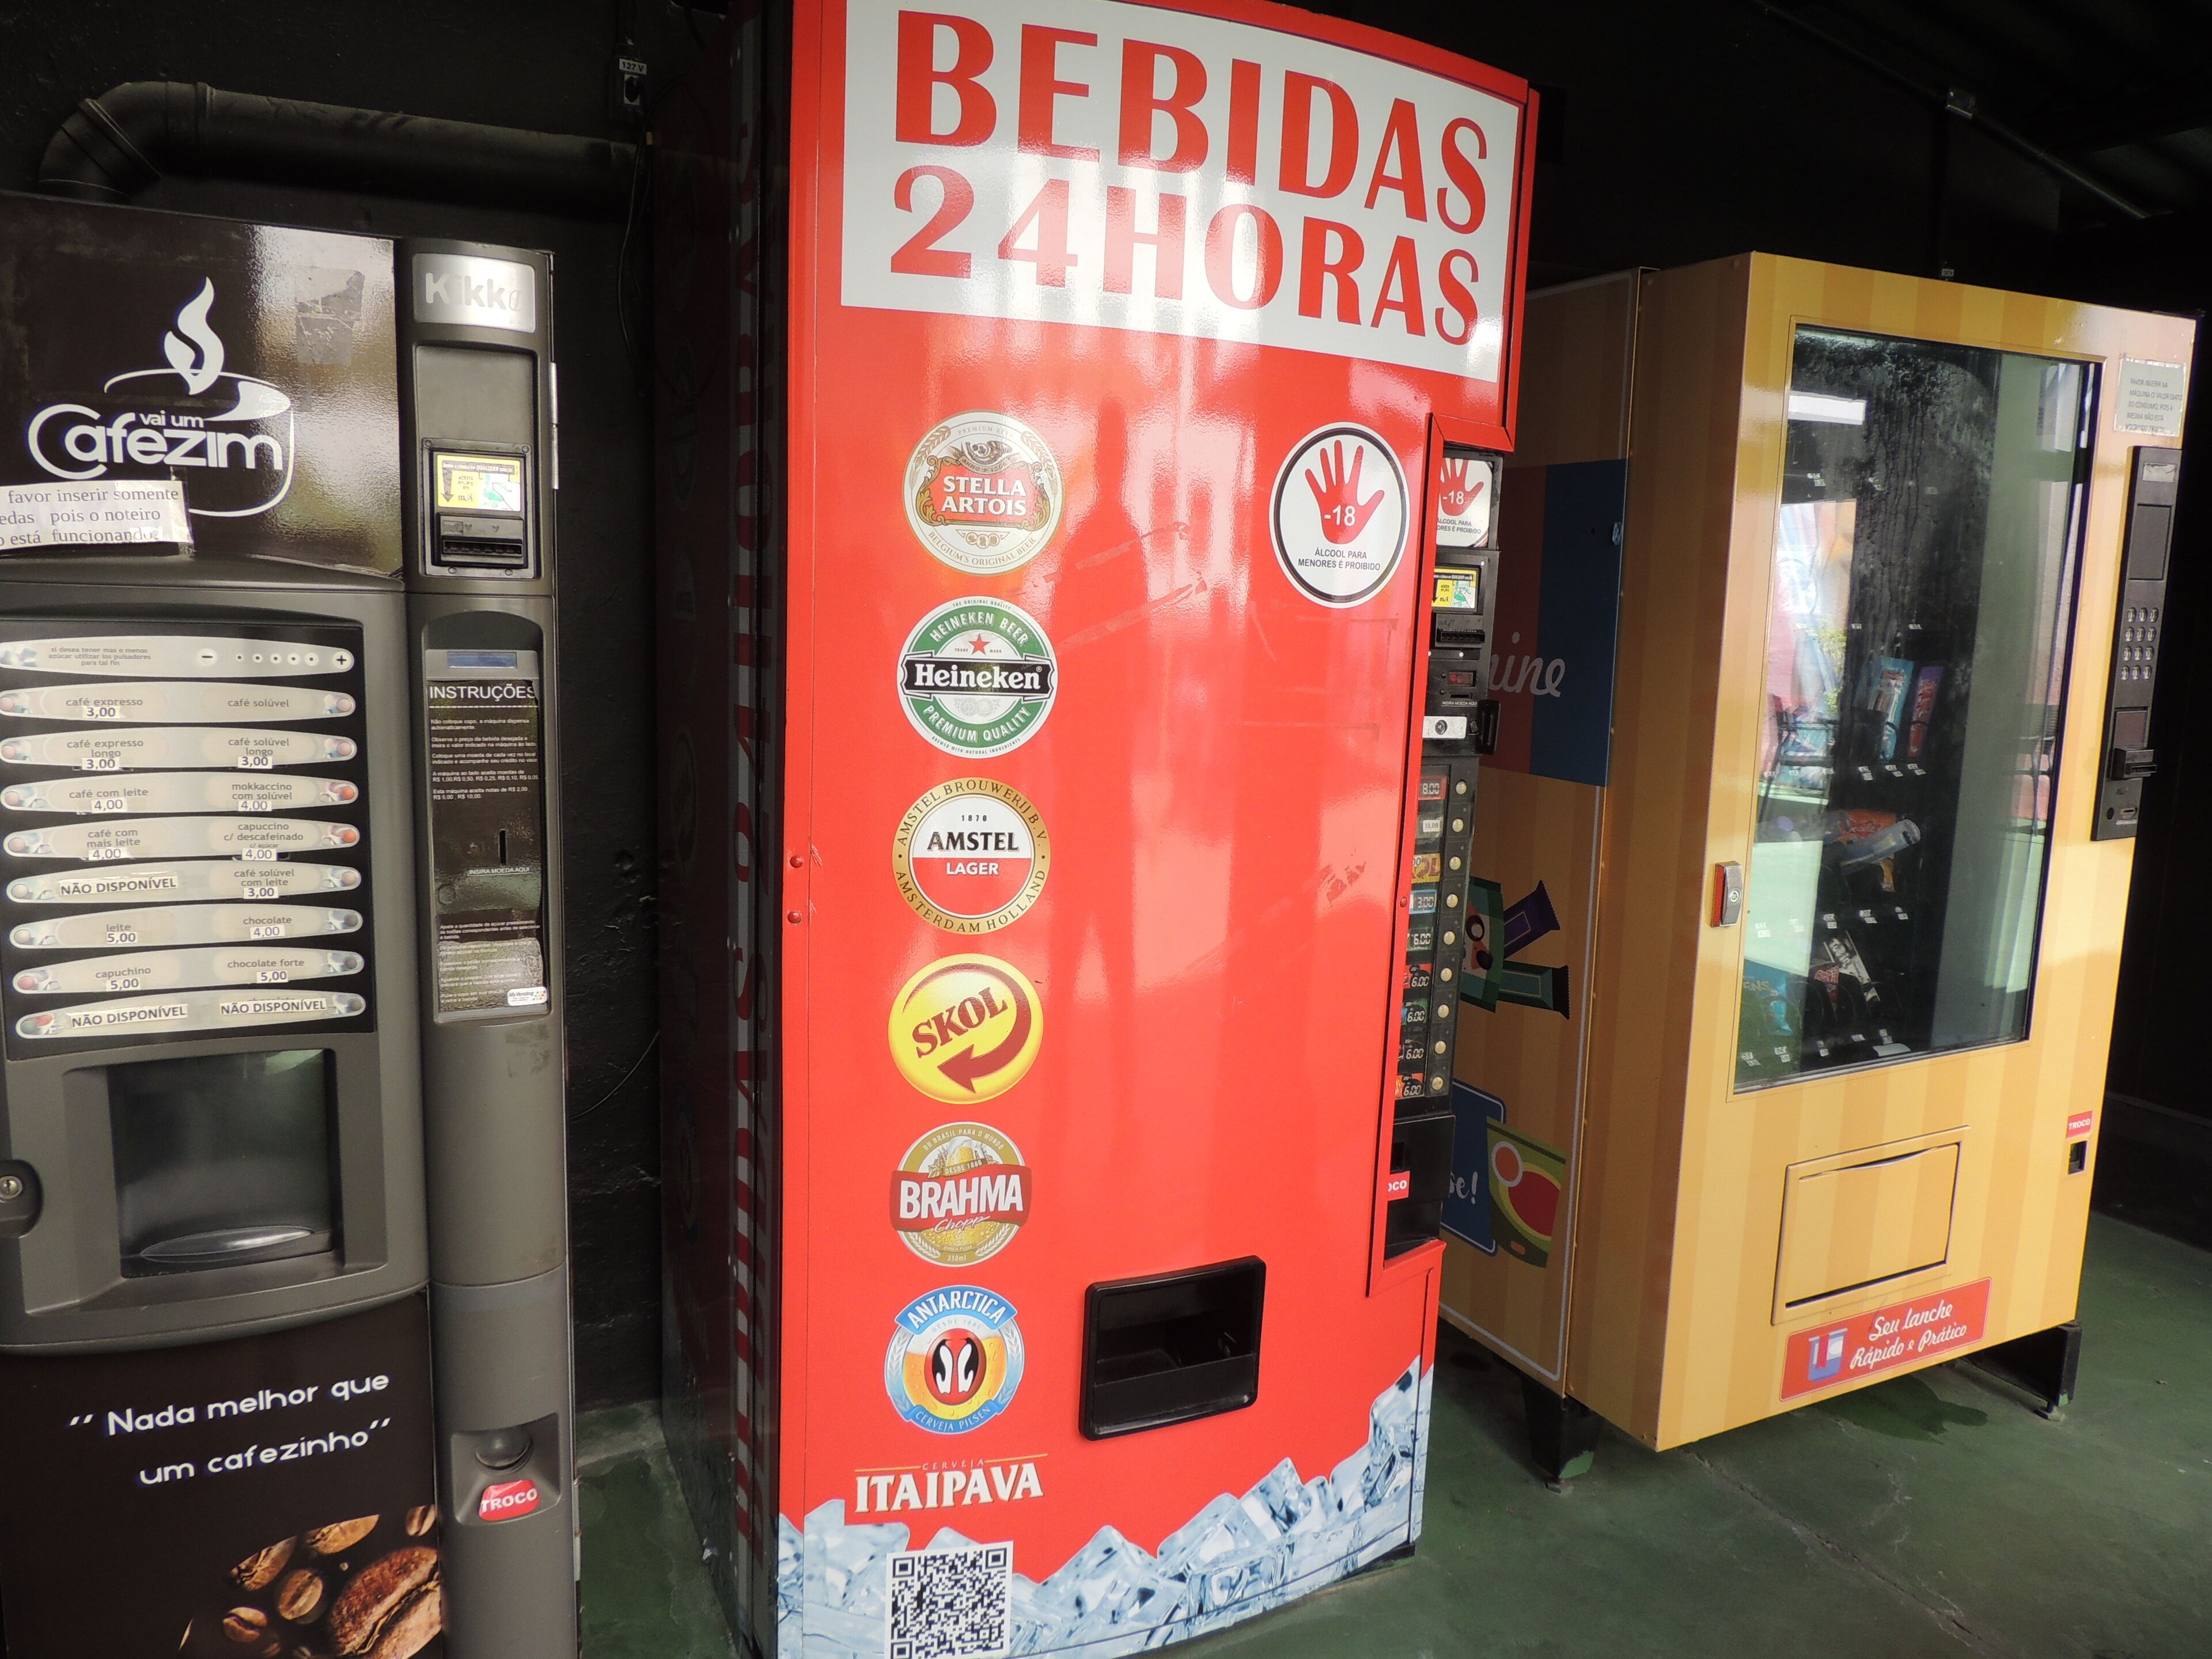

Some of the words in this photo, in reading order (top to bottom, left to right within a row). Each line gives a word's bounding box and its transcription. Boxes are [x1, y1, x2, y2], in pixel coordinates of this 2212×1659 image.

[896, 10, 1488, 234] BEBIDAS
[139, 411, 165, 427] vai
[171, 414, 203, 428] um
[28, 404, 283, 479] Cafezim
[942, 476, 1027, 496] STELLA
[8, 491, 51, 503] favor
[57, 488, 108, 502] inserir
[113, 489, 179, 500] somente
[1443, 490, 1464, 505] -18
[941, 496, 1027, 516] ARTOIS
[50, 509, 84, 525] pois
[90, 512, 99, 521] o
[105, 508, 161, 521] noteiro
[1324, 505, 1355, 526] -18
[10, 530, 41, 545] está
[928, 531, 969, 563] BELGIUM'S
[972, 550, 1017, 566] ORIGINAL
[1016, 537, 1036, 558] BEER
[1315, 547, 1346, 558] ÁLCOOL
[1348, 551, 1367, 559] PARA
[1298, 559, 1336, 568] MENORES
[1339, 558, 1343, 569] É
[1345, 562, 1380, 570] PROIBIDO
[991, 600, 1011, 610] QUALITY
[930, 612, 995, 642] HEINEKEN
[999, 618, 1029, 647] BEER
[914, 664, 1040, 689] Heineken
[430, 684, 535, 702] INSTRUÇÕES
[66, 698, 89, 706] café
[228, 699, 249, 707] café
[253, 699, 289, 707] solúvel
[87, 707, 116, 719] 3,00
[923, 705, 978, 743] PREMIUM
[983, 707, 1031, 741] QUALITY
[67, 740, 90, 748] café
[94, 740, 143, 749] expresso
[228, 738, 250, 746] café
[254, 738, 290, 746] solúvel
[990, 738, 1021, 753] INGREDIENTS
[92, 749, 121, 758] longo
[246, 747, 273, 756] longo
[87, 759, 115, 770] 3,00
[242, 756, 268, 767] 3,00
[232, 782, 292, 790] mokkaccino
[1422, 783, 1440, 794] 8.00
[69, 790, 93, 798] café
[124, 789, 148, 797] leite
[257, 791, 293, 800] solúvel
[94, 800, 123, 812] 4,00
[241, 801, 268, 811] 4,00
[897, 791, 941, 846] AMSTEL
[944, 779, 1032, 814] BROUWERIJ
[238, 823, 289, 832] capuccino
[88, 830, 111, 838] café
[237, 833, 304, 841] descafeinado
[87, 839, 112, 847] mais
[116, 838, 141, 847] leite
[927, 832, 1021, 852] AMSTEL
[93, 849, 121, 860] 4,00
[245, 850, 272, 860] 4,00
[234, 869, 256, 877] café
[259, 869, 294, 877] solúvel
[946, 862, 999, 876] LAGER
[61, 882, 92, 895] NÃO
[96, 877, 176, 892] DISPONÍVEL
[248, 888, 274, 898] 3,00
[896, 871, 981, 933] AMSTERDAM
[986, 870, 1046, 930] HOLLAND
[243, 916, 292, 925] chocolate
[253, 926, 280, 937] 4,00
[107, 933, 136, 944] 5,00
[1414, 933, 1431, 945] 6.00
[228, 959, 276, 968] chocolate
[280, 958, 305, 967] forte
[95, 966, 151, 979] capuchino
[260, 971, 287, 982] 5,00
[110, 979, 139, 991] 5,00
[1411, 976, 1429, 987] 6.00
[221, 1002, 249, 1015] NÃO
[253, 999, 327, 1013] DISPONÍVEL
[71, 1014, 103, 1028] NÃO
[107, 1006, 187, 1024] DISPONÍVEL
[1407, 1010, 1425, 1022] 6.00
[912, 987, 1008, 1059] SKOL
[1406, 1048, 1424, 1059] 6.00
[1403, 1085, 1421, 1096] 6.00
[2069, 1119, 2090, 1130] TROCO
[923, 1142, 932, 1151] DO
[933, 1130, 956, 1143] BRASIL
[984, 1132, 1005, 1150] MUNDO
[945, 1164, 965, 1174] DESDE
[900, 1175, 1024, 1218] BRAHMA
[934, 1215, 991, 1233] Chopp
[907, 1290, 1007, 1330] ANTARCTICA
[1869, 1317, 1900, 1341] Seu
[1902, 1300, 1953, 1331] lanche
[1850, 1338, 1904, 1370] Rápido
[1908, 1340, 1915, 1351] e
[1918, 1323, 1968, 1353] Prático
[108, 1406, 195, 1436] Nada
[207, 1386, 318, 1418] melhor
[331, 1374, 389, 1402] que
[916, 1411, 954, 1431] CERVEJA
[959, 1406, 991, 1429] PILSEN
[922, 1459, 984, 1471] CERVEJA
[139, 1461, 194, 1484] um
[855, 1463, 1044, 1513] ITAIPAVA
[481, 1488, 537, 1513] TROCO
